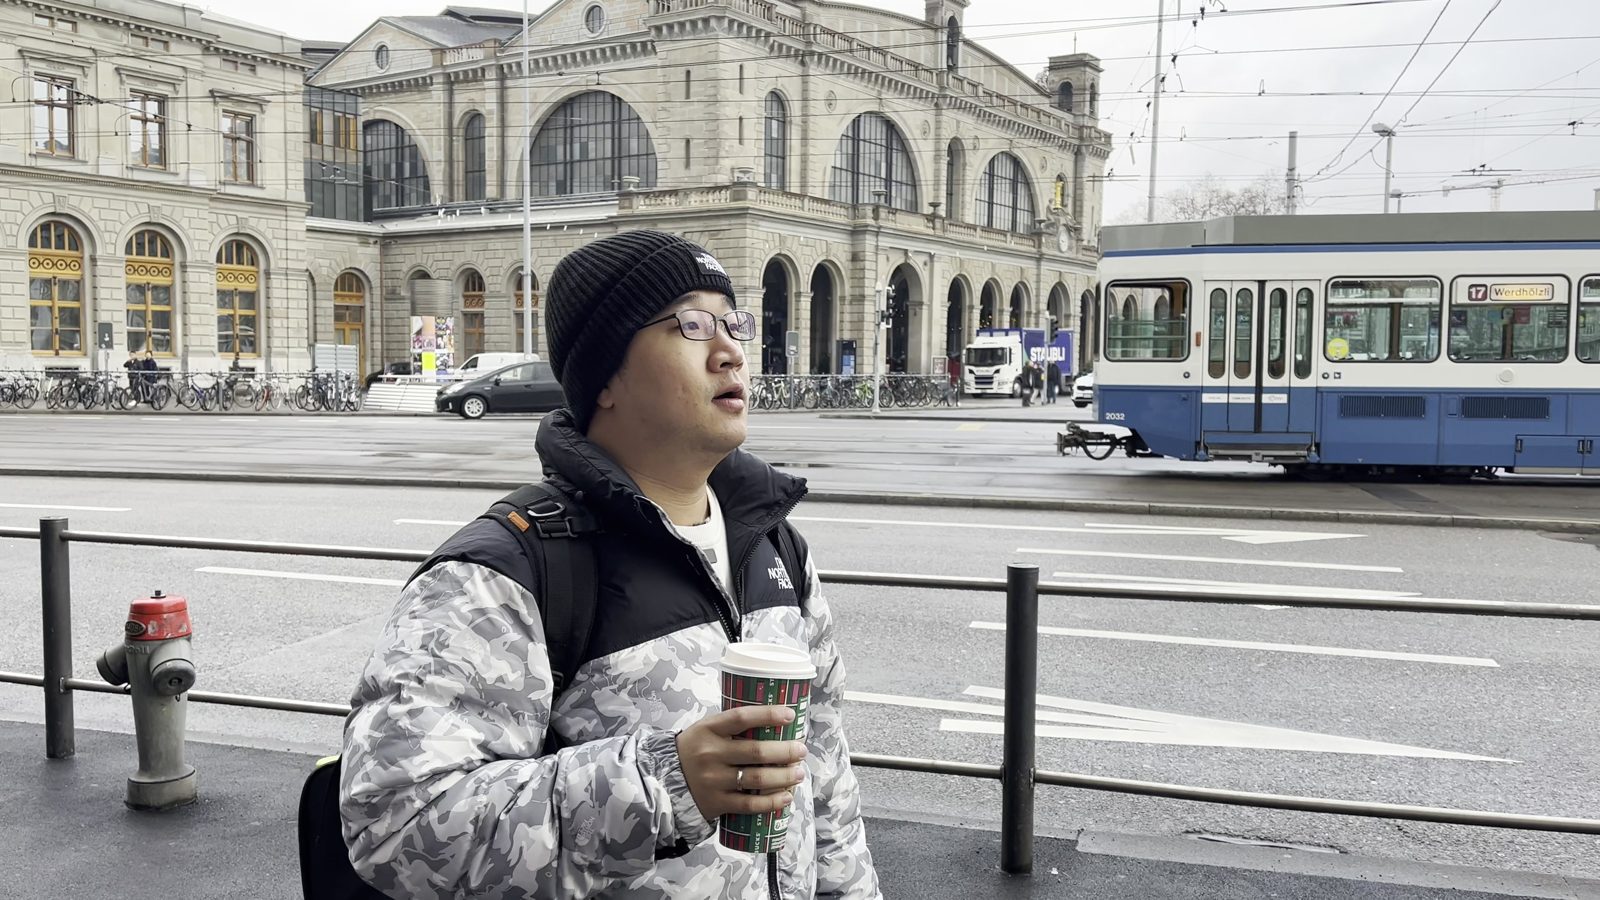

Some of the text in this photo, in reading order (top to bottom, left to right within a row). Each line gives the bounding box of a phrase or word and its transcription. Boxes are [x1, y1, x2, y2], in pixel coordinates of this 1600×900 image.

[1469, 287, 1550, 299] 17 Werdhölzli
[1105, 412, 1125, 420] 2032
